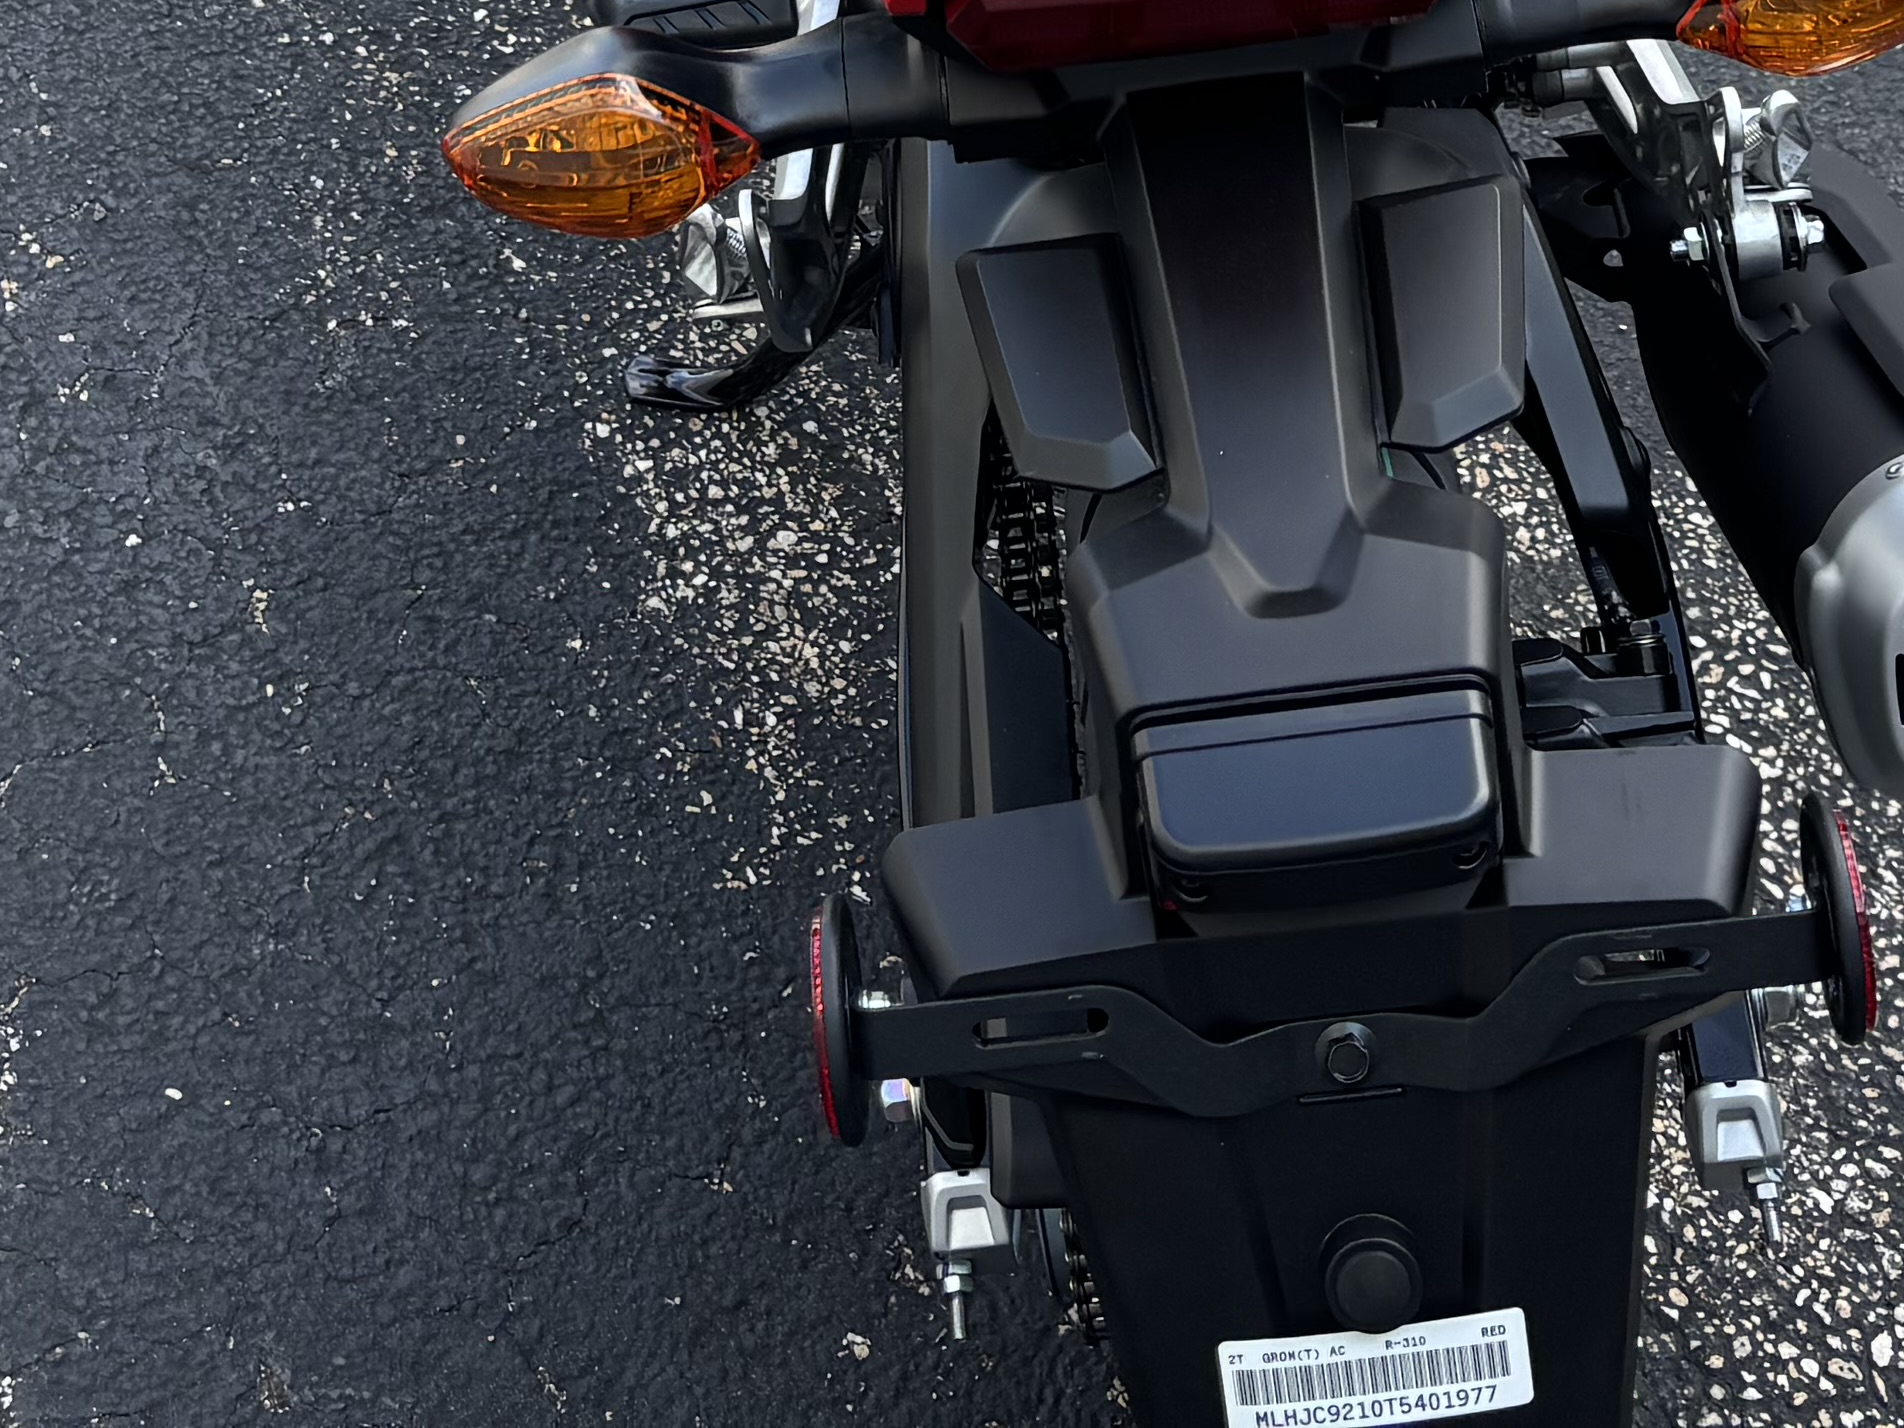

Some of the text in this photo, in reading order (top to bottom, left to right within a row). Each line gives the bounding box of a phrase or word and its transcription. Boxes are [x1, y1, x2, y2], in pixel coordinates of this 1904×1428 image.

[1228, 1353, 1244, 1365] 2T
[1329, 1345, 1346, 1358] AC
[1480, 1324, 1507, 1338] RED
[1255, 1383, 1498, 1428] MLHJC9210T5401977
